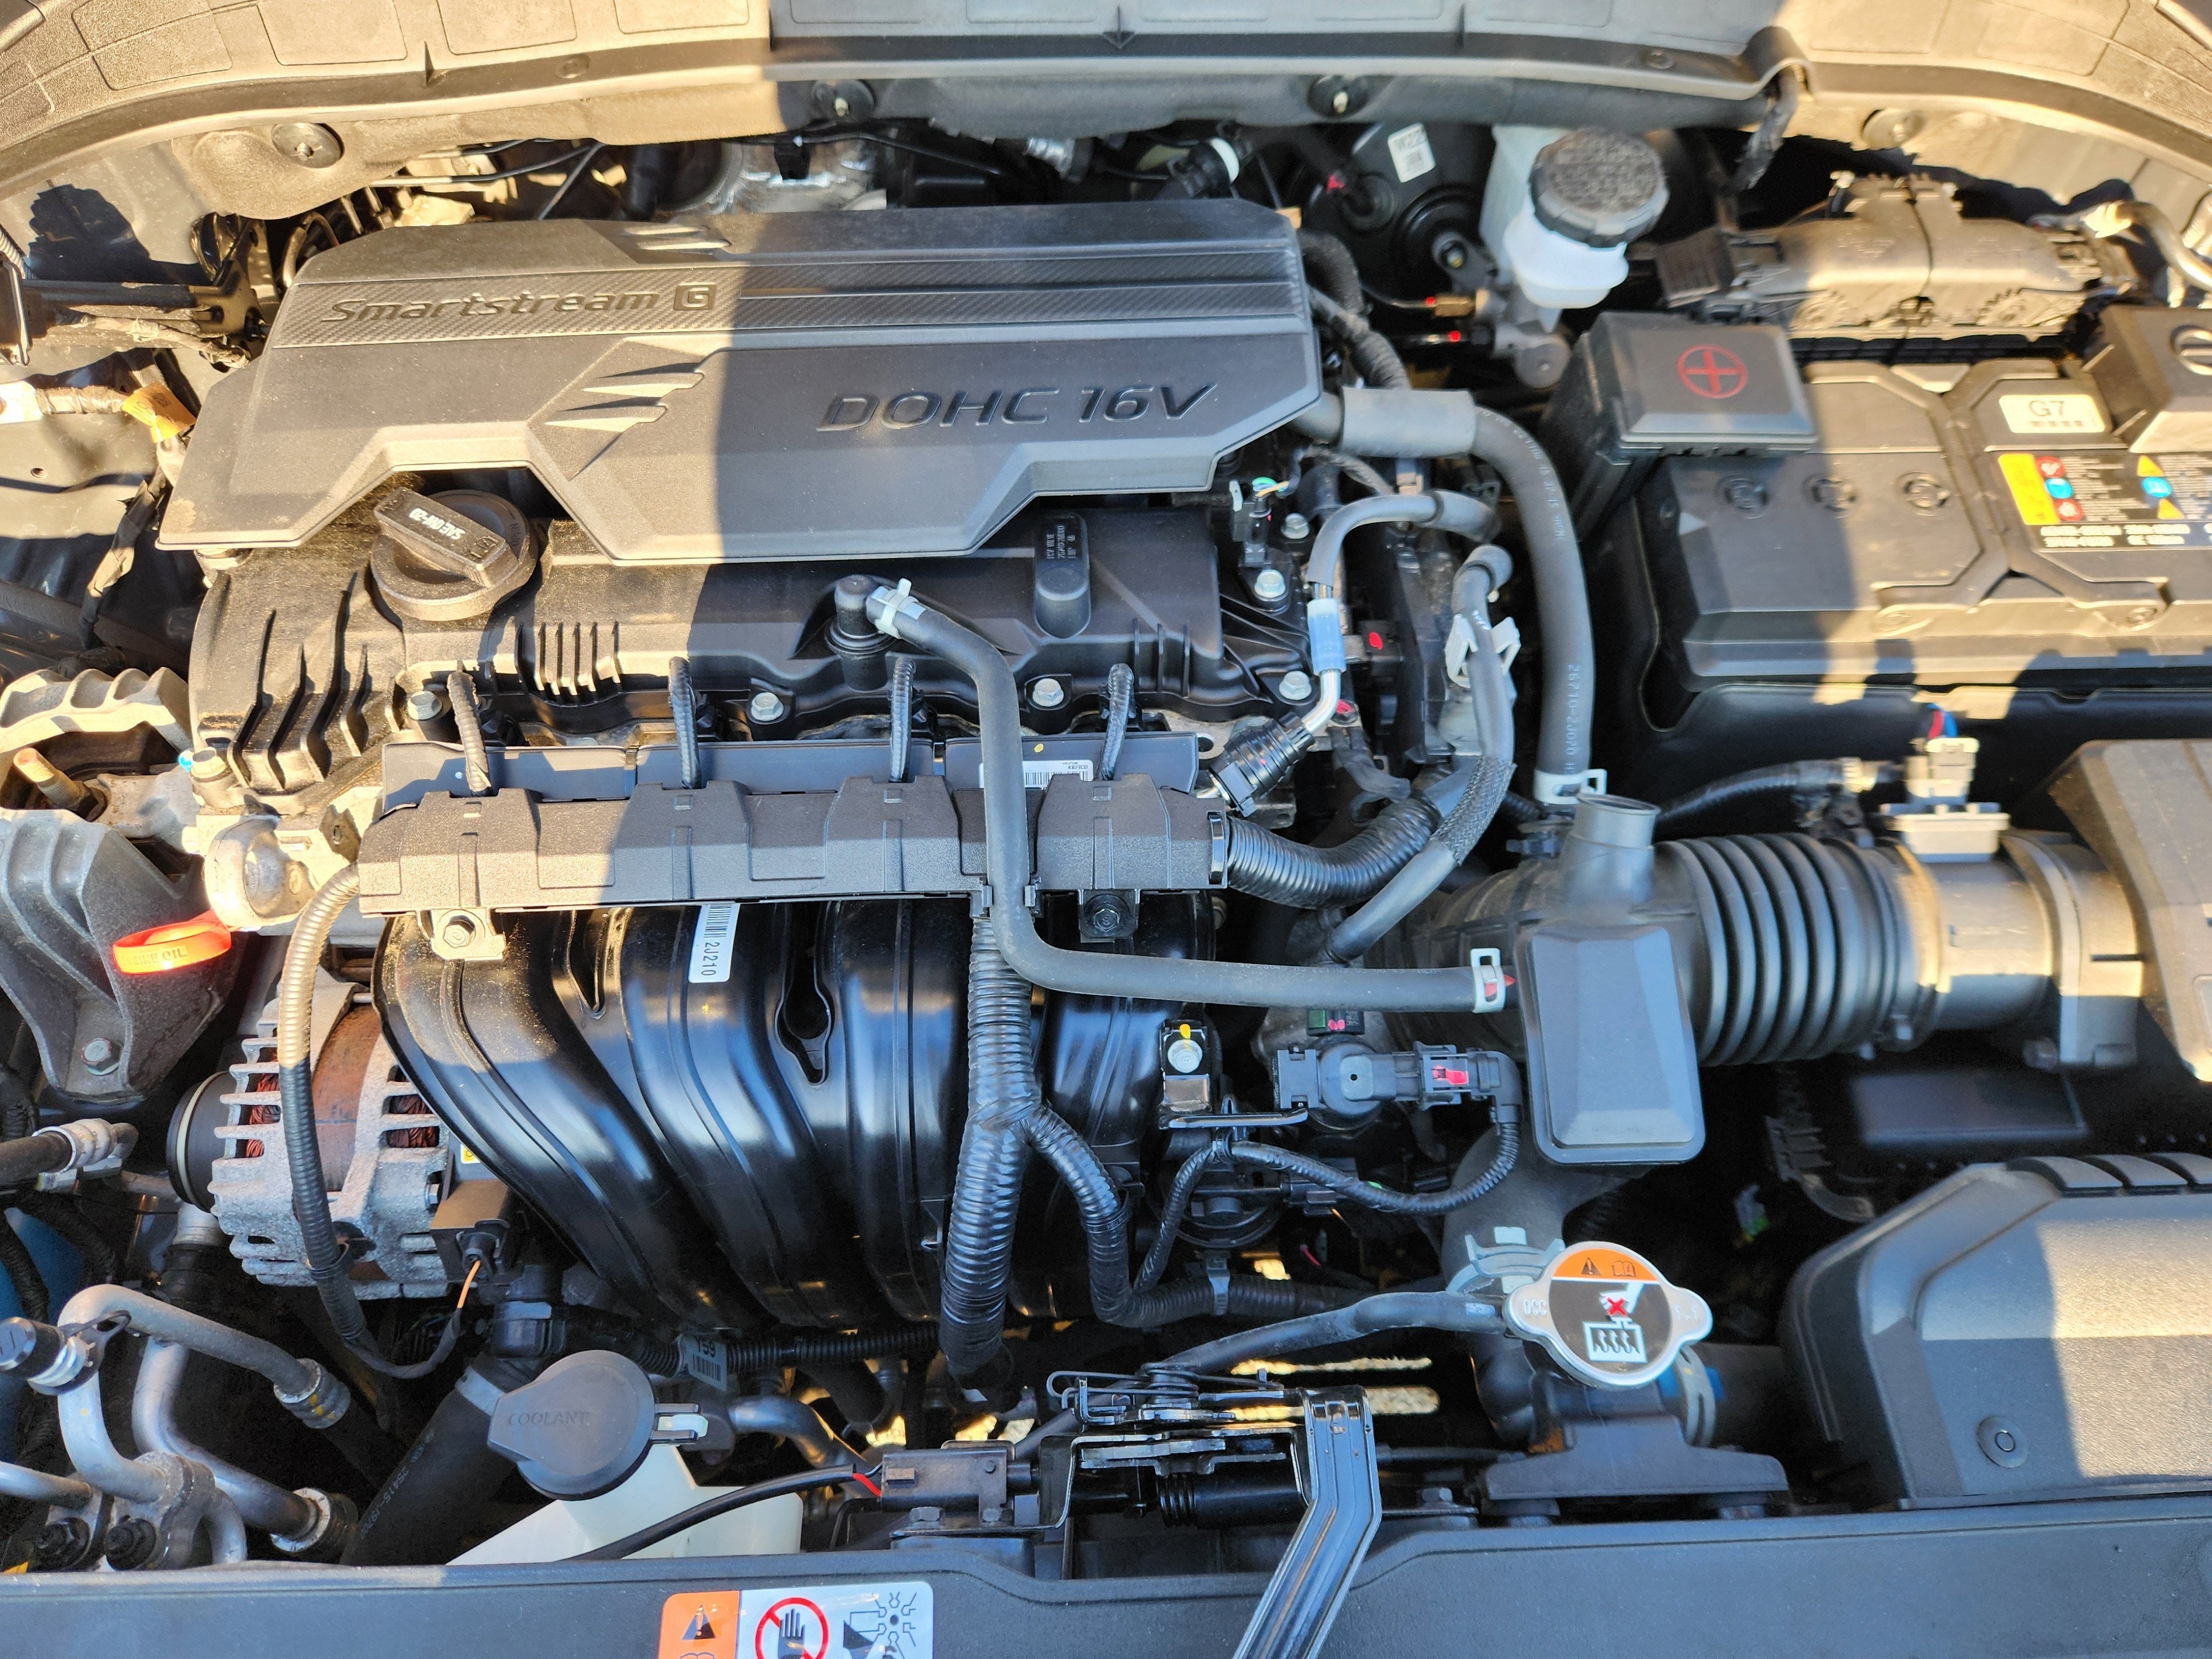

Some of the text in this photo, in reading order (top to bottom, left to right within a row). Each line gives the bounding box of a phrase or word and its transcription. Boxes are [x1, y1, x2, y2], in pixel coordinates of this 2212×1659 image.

[321, 284, 714, 322] Smartstream G
[816, 383, 1218, 431] DOHC 16V
[2028, 400, 2064, 416] G7
[408, 508, 466, 540] SAE 0W-20
[162, 947, 189, 961] OIL
[701, 942, 721, 976] 2J210
[1524, 1299, 1548, 1317] DCC
[508, 1410, 591, 1426] COOLANT
